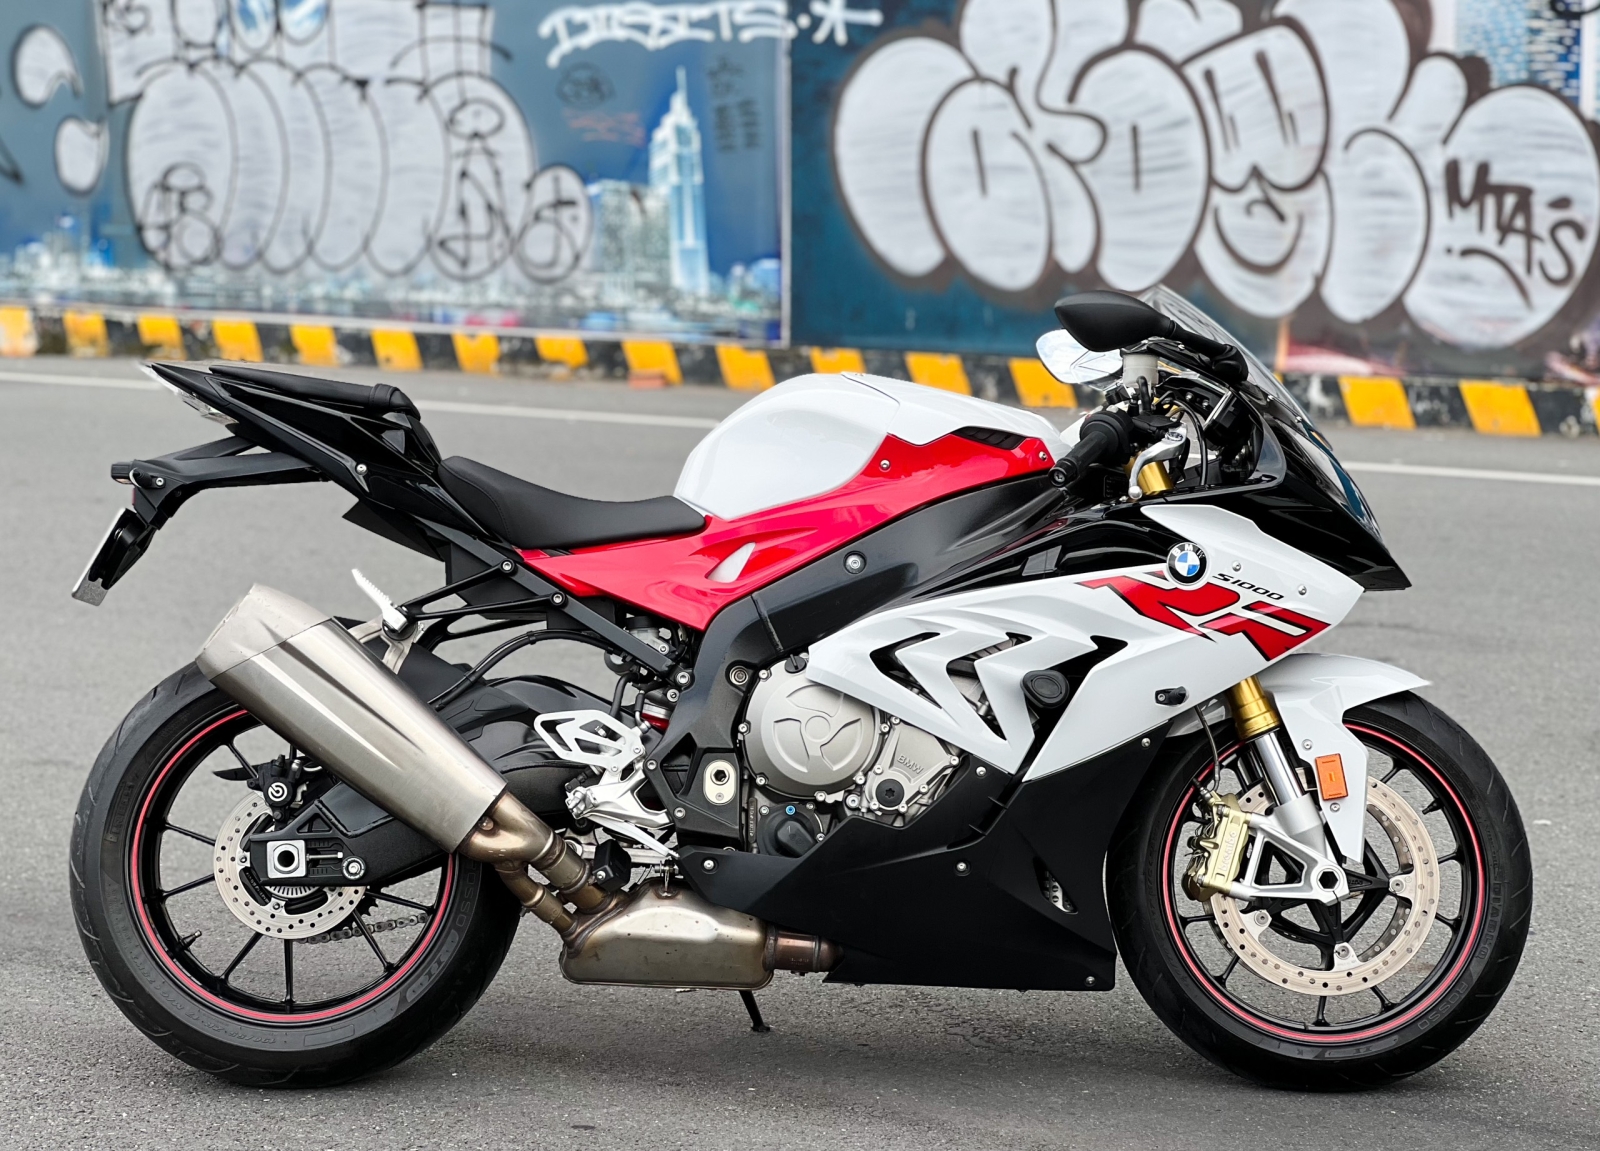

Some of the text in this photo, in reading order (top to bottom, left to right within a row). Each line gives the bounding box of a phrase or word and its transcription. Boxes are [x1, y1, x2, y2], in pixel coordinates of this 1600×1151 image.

[1171, 543, 1206, 560] BMW
[1212, 572, 1285, 601] S1000
[896, 755, 925, 774] BMW
[1218, 831, 1237, 872] brembo
[1417, 981, 1469, 1032] ROSSO
